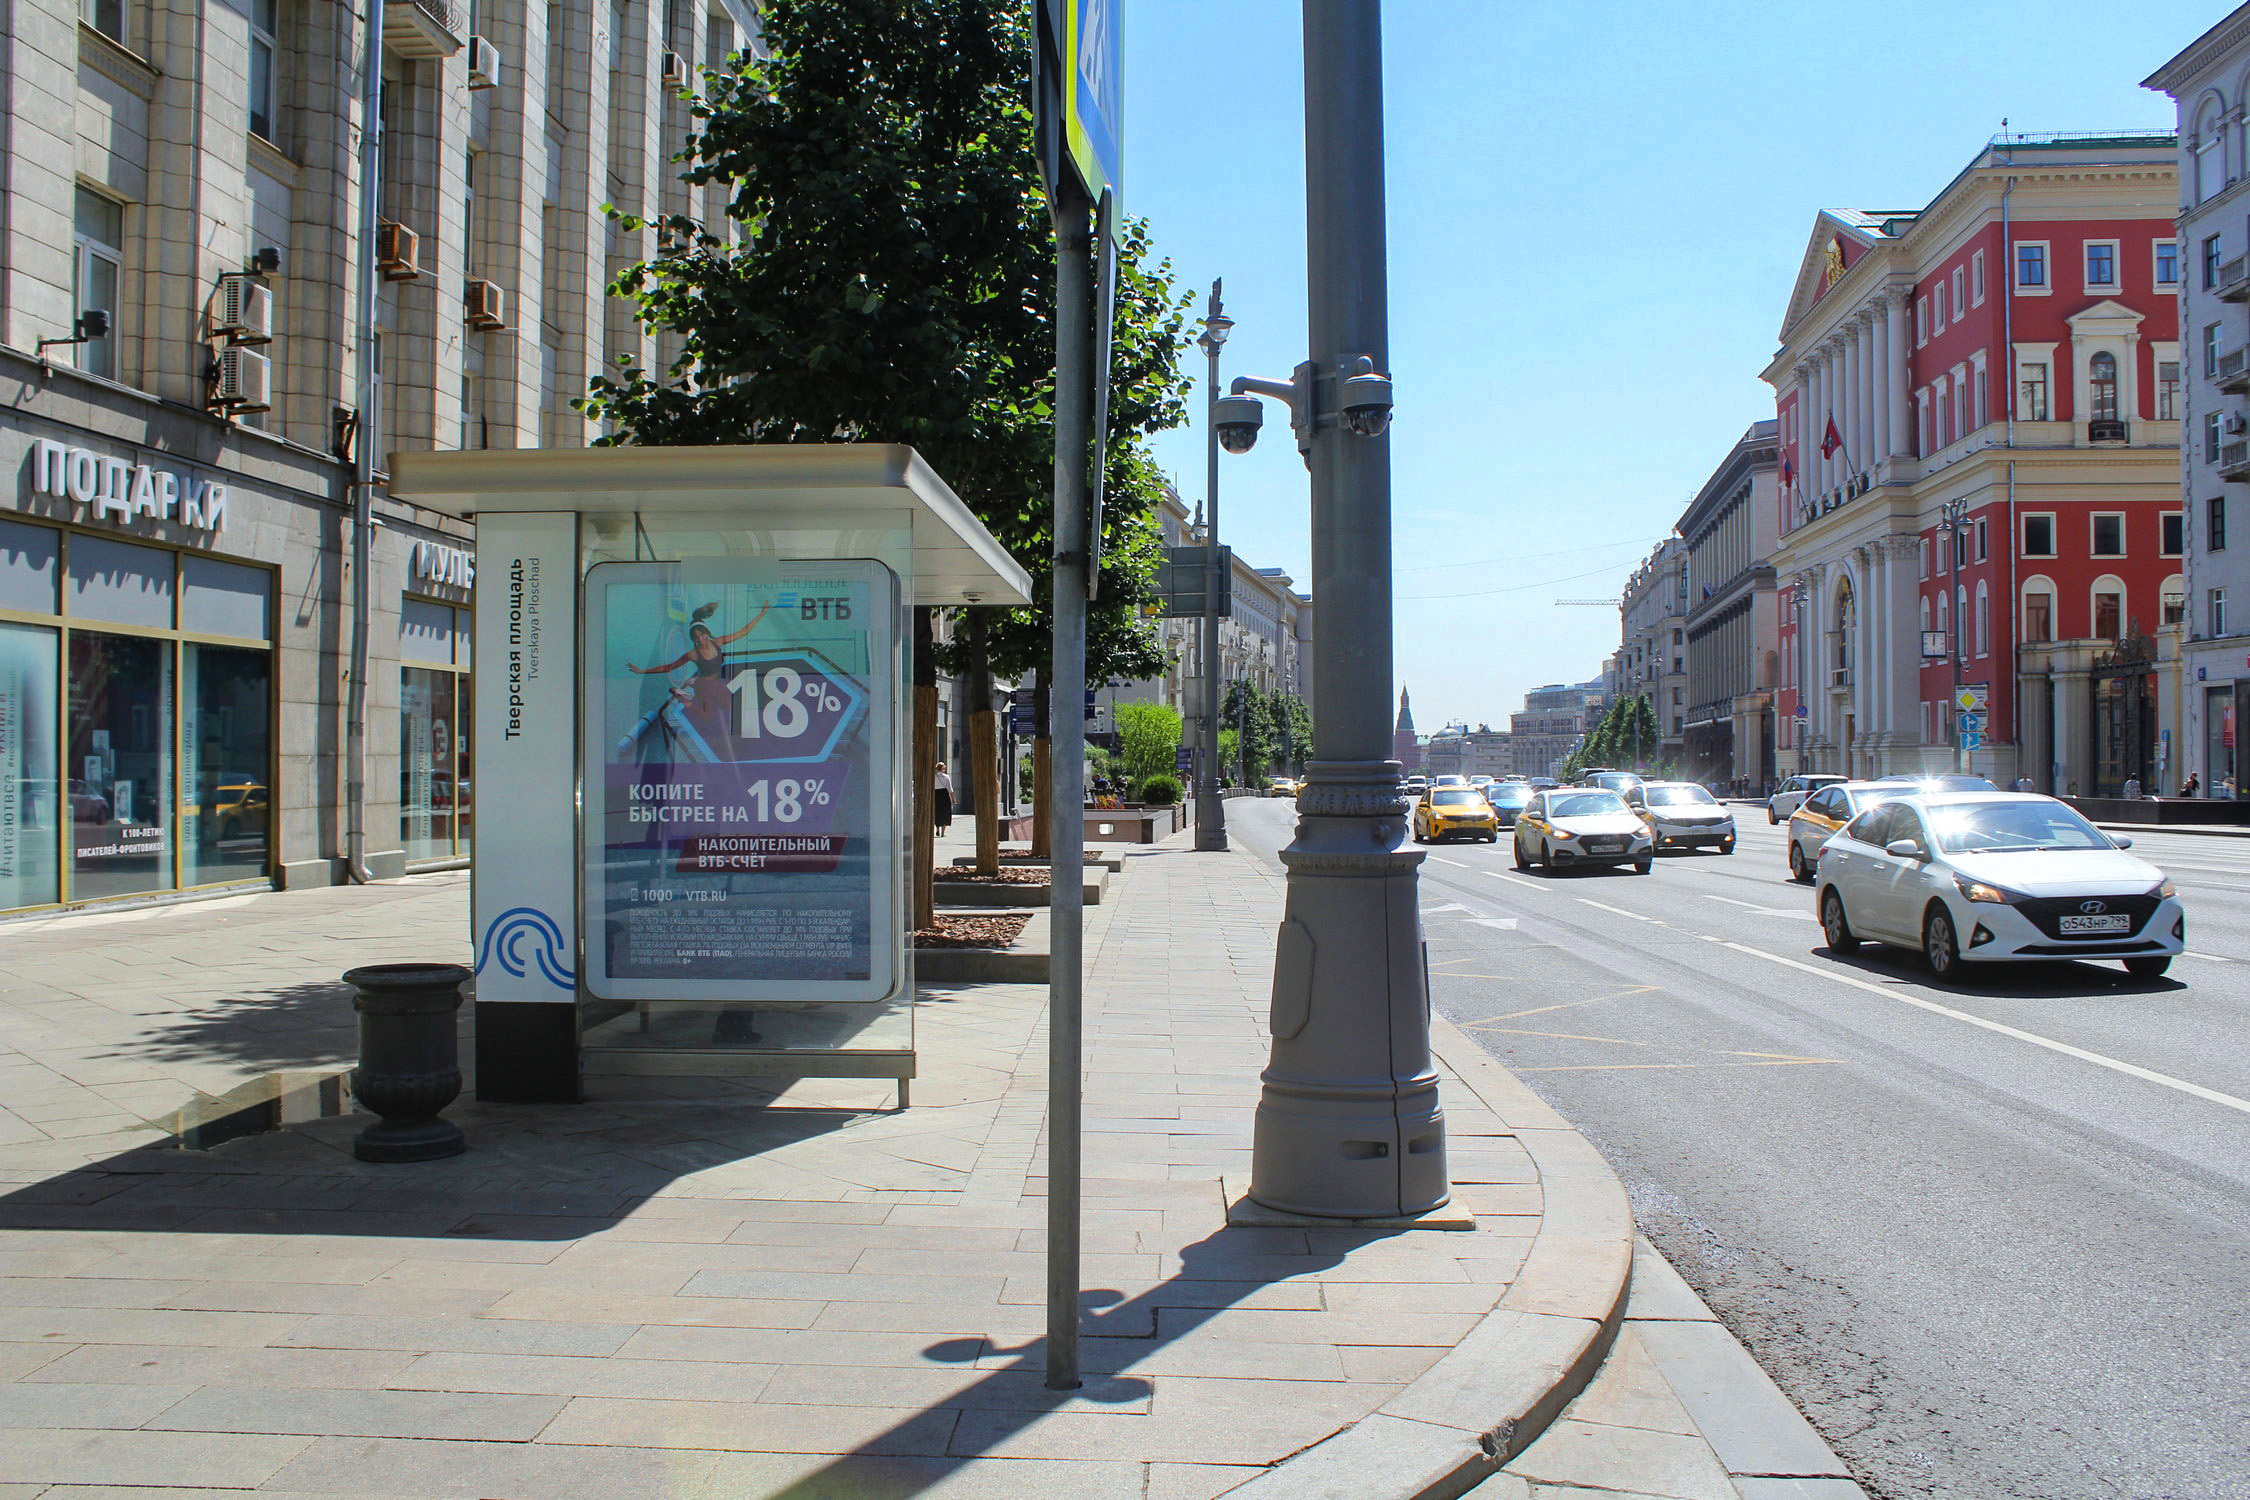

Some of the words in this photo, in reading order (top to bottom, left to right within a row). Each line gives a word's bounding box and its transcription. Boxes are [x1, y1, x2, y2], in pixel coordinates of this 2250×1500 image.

[33, 438, 227, 532] ПОДАРКИ
[416, 540, 476, 589] КУЛЬ
[528, 557, 540, 615] Ploschad
[509, 558, 524, 645] площадь
[801, 597, 852, 621] ВТБ
[528, 618, 541, 681] Tverskaya
[505, 650, 524, 741] Тверская
[726, 667, 842, 738] 18%
[629, 784, 704, 800] КОПИТЕ
[629, 806, 715, 822] БЫСТРЕЕ
[722, 806, 749, 822] НА
[747, 778, 830, 823] 18%
[1, 774, 15, 879] #читаютвсе
[122, 829, 128, 838] К
[128, 827, 165, 838] 100-ЛЕТИЮ
[698, 836, 831, 851] НАКОПИТЕЛЬНЫЙ
[77, 841, 165, 858] ПИСАТЕЛЕЙ-ФРОНТОВИКОВ
[698, 852, 767, 868] ВТБ-СЧЁТ
[642, 889, 673, 902] 1000
[686, 890, 727, 902] VTB.RU
[677, 949, 696, 957] БАНК
[697, 949, 711, 957] ВТБ
